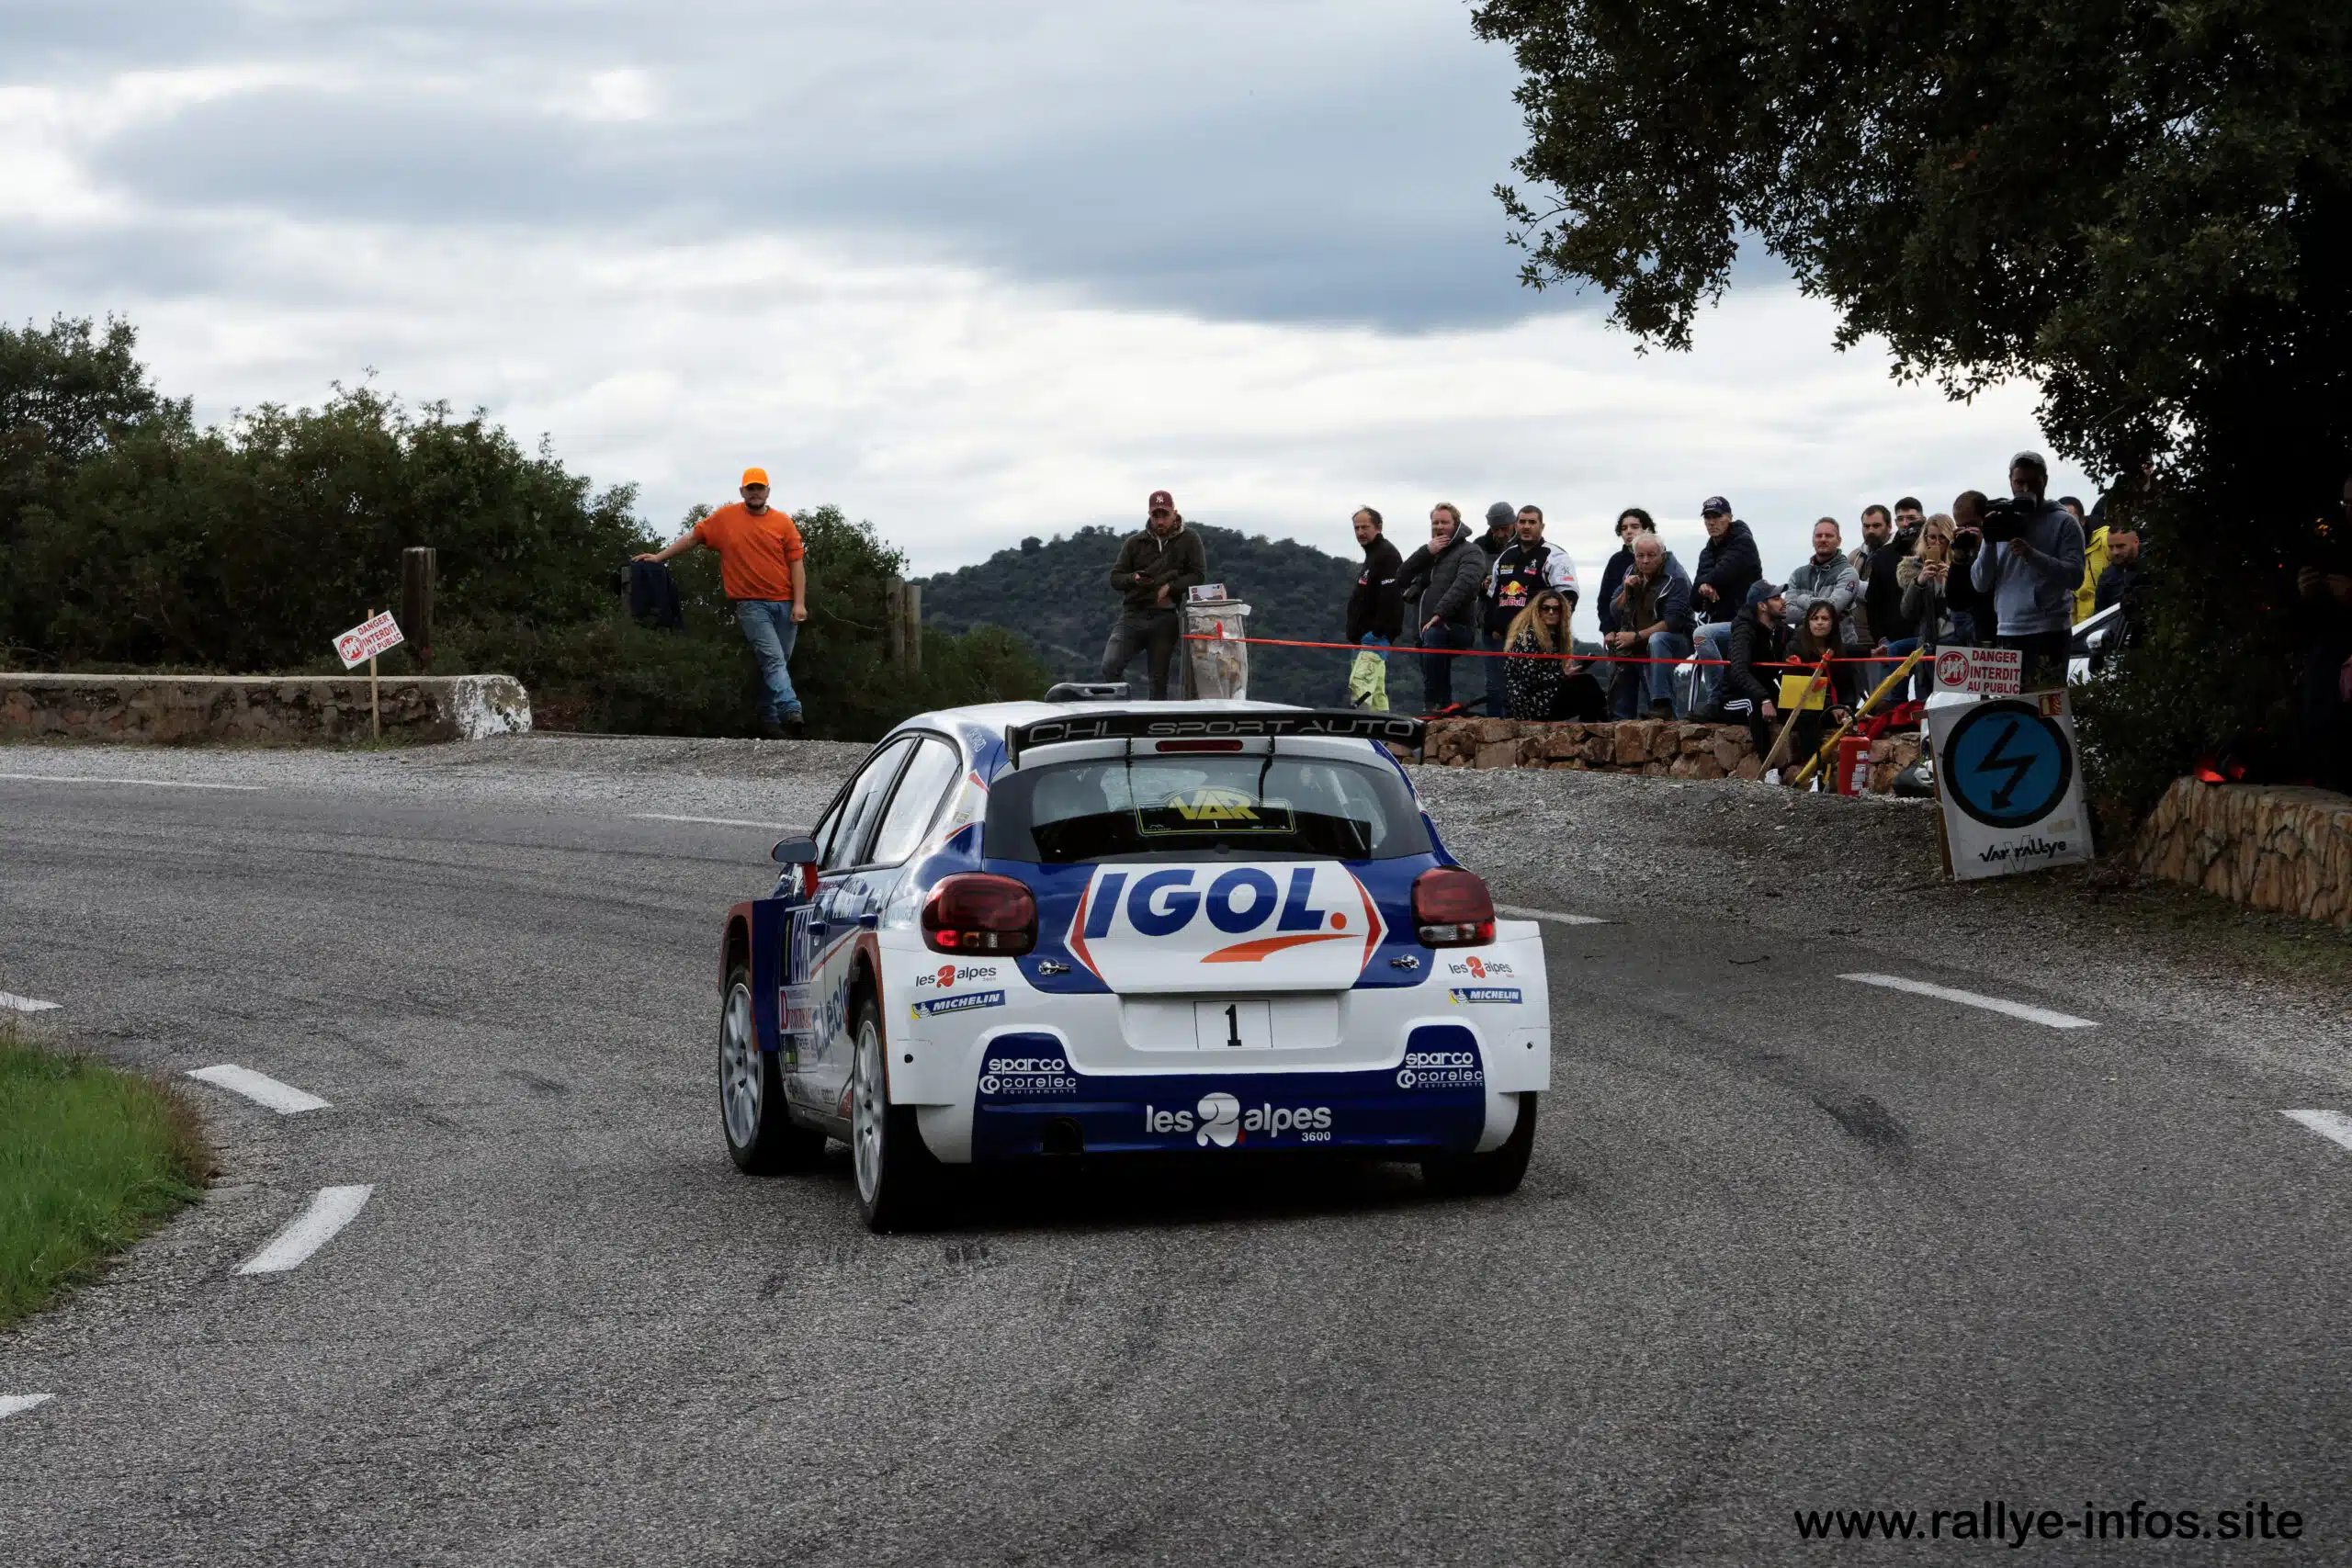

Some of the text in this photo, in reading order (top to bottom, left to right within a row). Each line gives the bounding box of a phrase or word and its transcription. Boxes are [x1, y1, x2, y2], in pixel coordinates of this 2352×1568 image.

[357, 614, 390, 636] DANGER
[362, 623, 397, 647] INTERDIT
[367, 632, 402, 656] AU PUBLIC
[1972, 649, 2018, 663] DANGER
[1970, 665, 2020, 682] INTERDIT
[1967, 681, 2019, 694] AU PUBLIC
[1029, 719, 1415, 743] CHL SPORT AUTO
[1168, 789, 1261, 820] VAR
[915, 964, 997, 987] les 2 alpes
[1448, 955, 1512, 979] les 2 alpes
[933, 993, 1001, 1011] MICHELIN
[1470, 990, 1520, 999] MICHELIN
[1224, 1003, 1242, 1047] 1
[989, 1058, 1065, 1075] sparco
[1406, 1052, 1474, 1069] sparco
[1002, 1074, 1077, 1088] corelec
[1418, 1068, 1483, 1081] corelec
[1146, 1092, 1332, 1147] les 2 alpes
[1301, 1131, 1331, 1142] 3600
